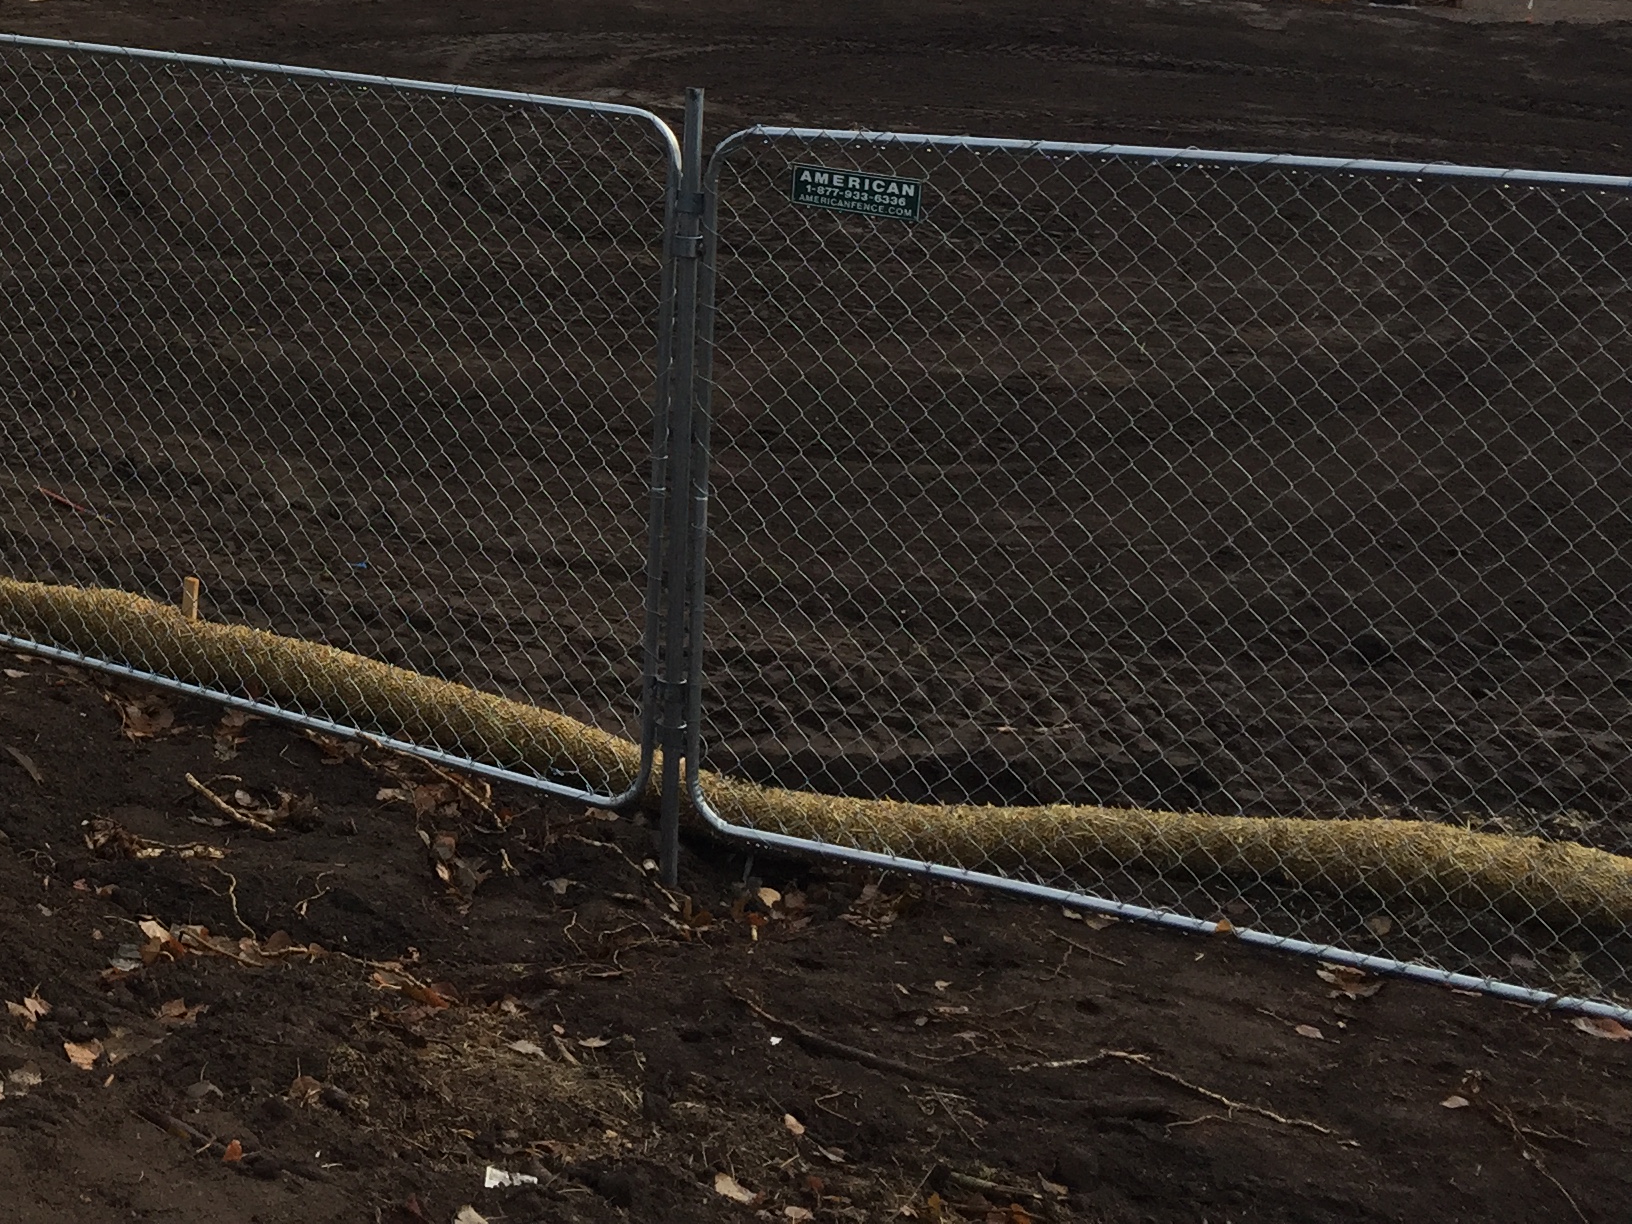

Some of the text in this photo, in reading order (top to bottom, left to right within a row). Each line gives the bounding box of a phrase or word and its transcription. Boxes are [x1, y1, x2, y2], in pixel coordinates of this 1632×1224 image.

[799, 170, 915, 196] AMERICAN
[798, 194, 912, 216] AMERICANFENCE.COM
[806, 184, 906, 206] 1-877-933-6336
